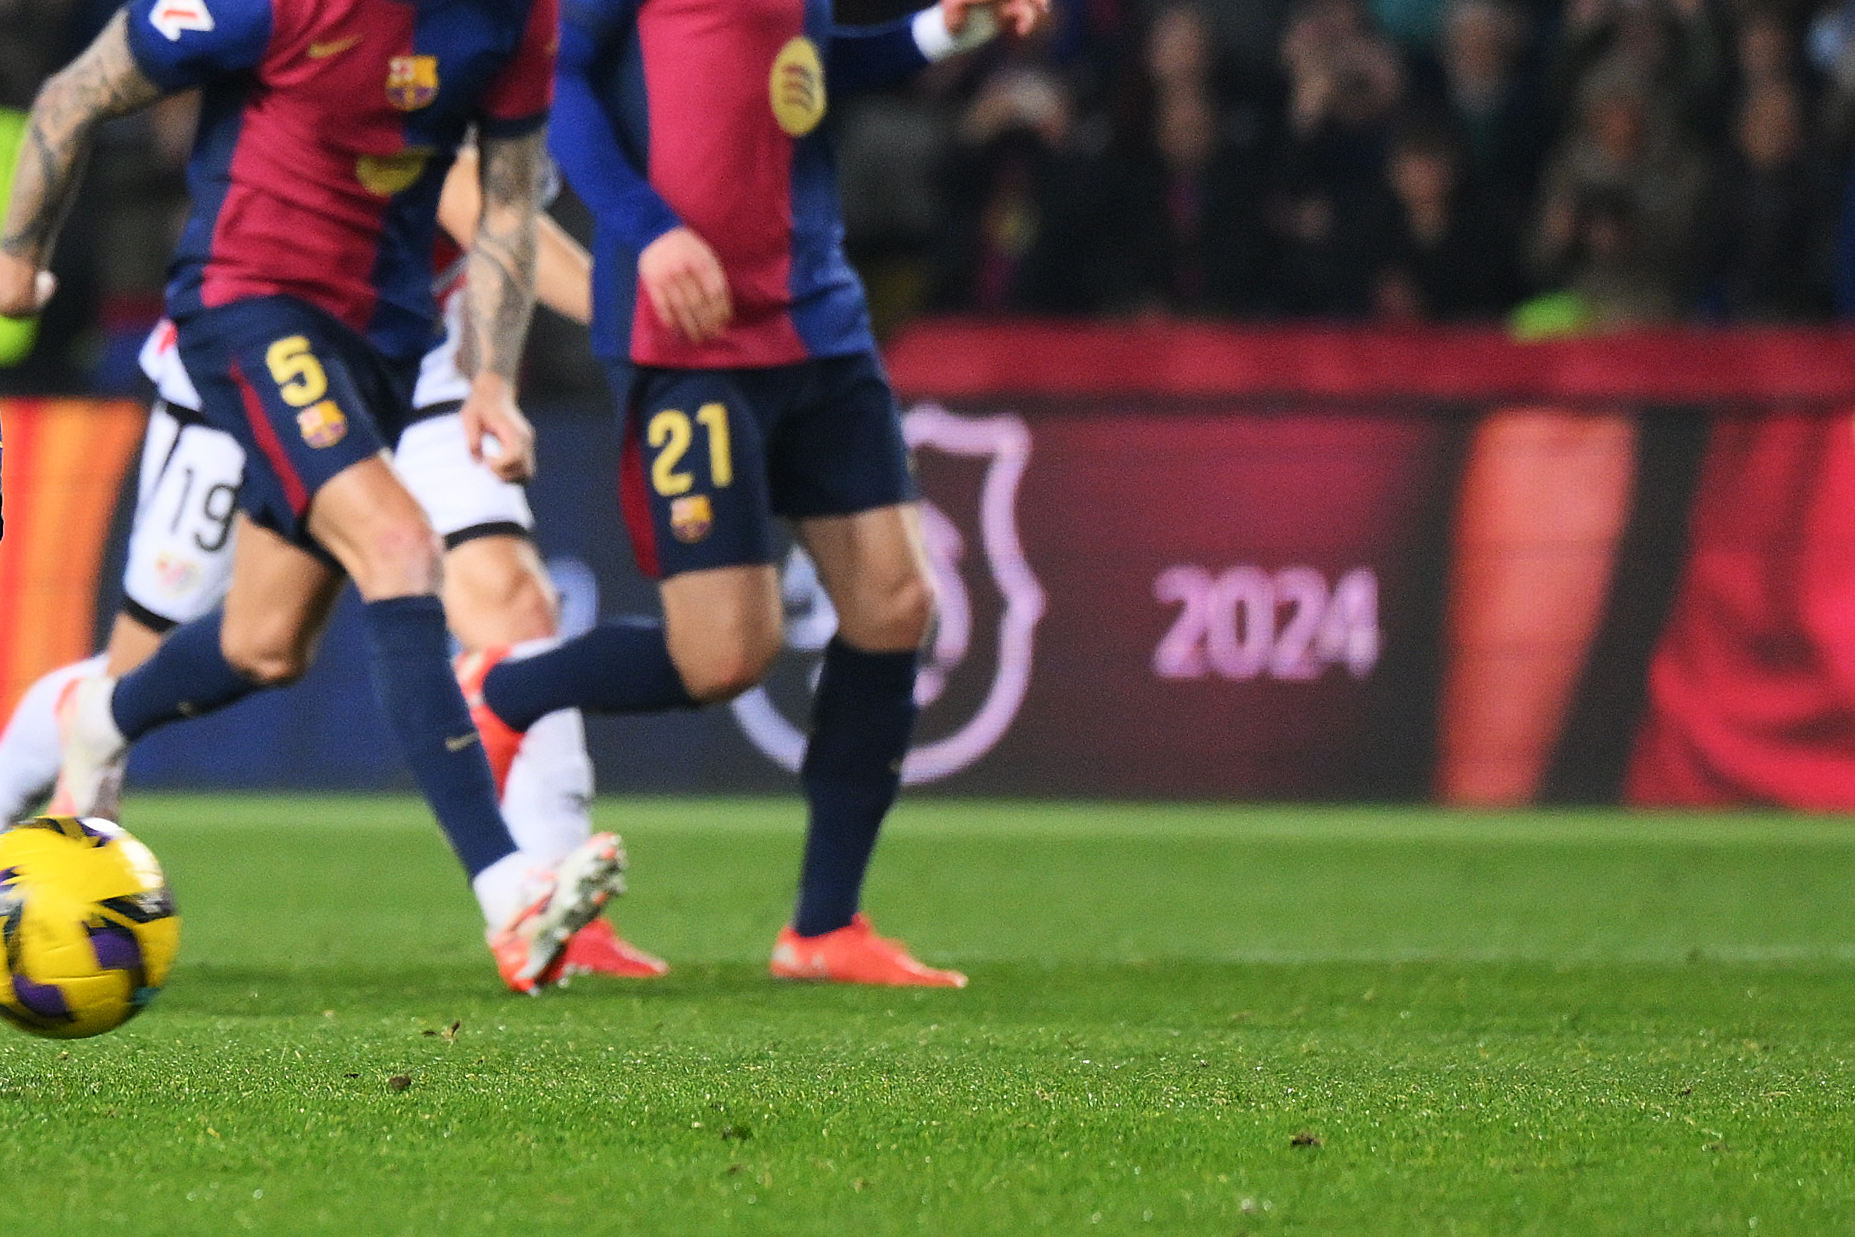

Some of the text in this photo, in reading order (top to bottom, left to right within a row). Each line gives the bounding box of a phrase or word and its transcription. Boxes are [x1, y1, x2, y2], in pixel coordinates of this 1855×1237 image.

[265, 334, 329, 408] 5
[648, 402, 733, 497] 21
[168, 466, 240, 553] 19
[1153, 563, 1383, 680] 2024
